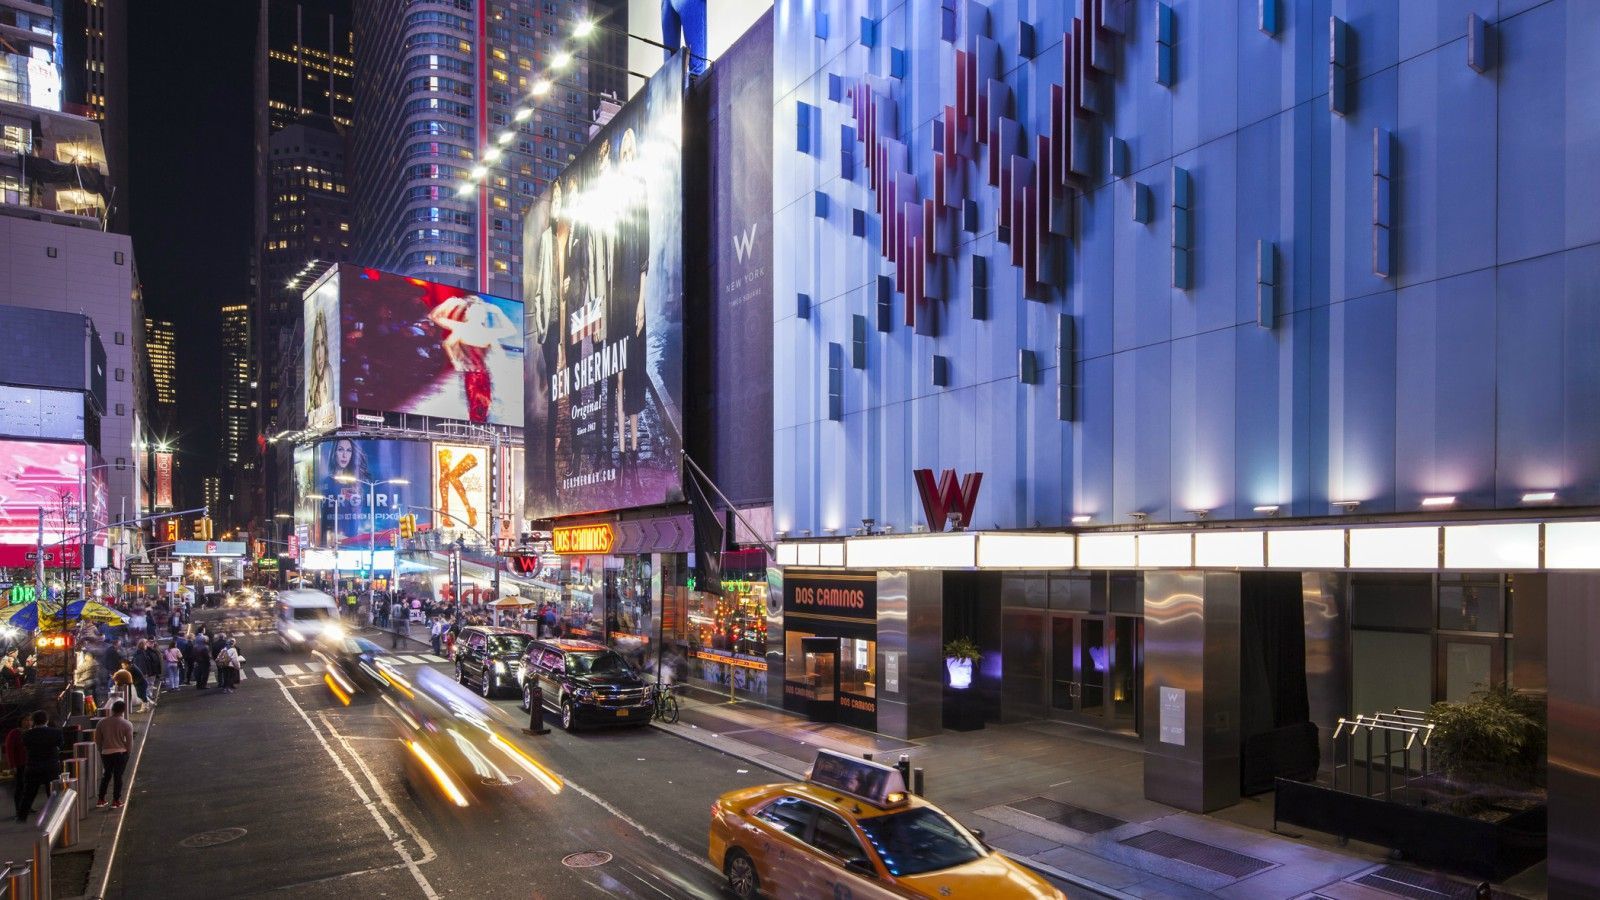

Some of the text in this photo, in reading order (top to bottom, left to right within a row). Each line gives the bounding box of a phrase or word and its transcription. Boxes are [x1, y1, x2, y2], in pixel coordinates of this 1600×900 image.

[733, 223, 757, 264] W
[726, 266, 765, 293] NEW YORK
[552, 336, 629, 401] BEN SHERMAN
[571, 394, 602, 420] Original
[914, 468, 984, 533] W
[555, 526, 608, 552] DOS CAMINOS
[520, 556, 537, 572] W
[795, 586, 865, 609] DOS CAMINOS
[840, 696, 875, 712] DOS CAMINOS
[1167, 692, 1178, 702] W
